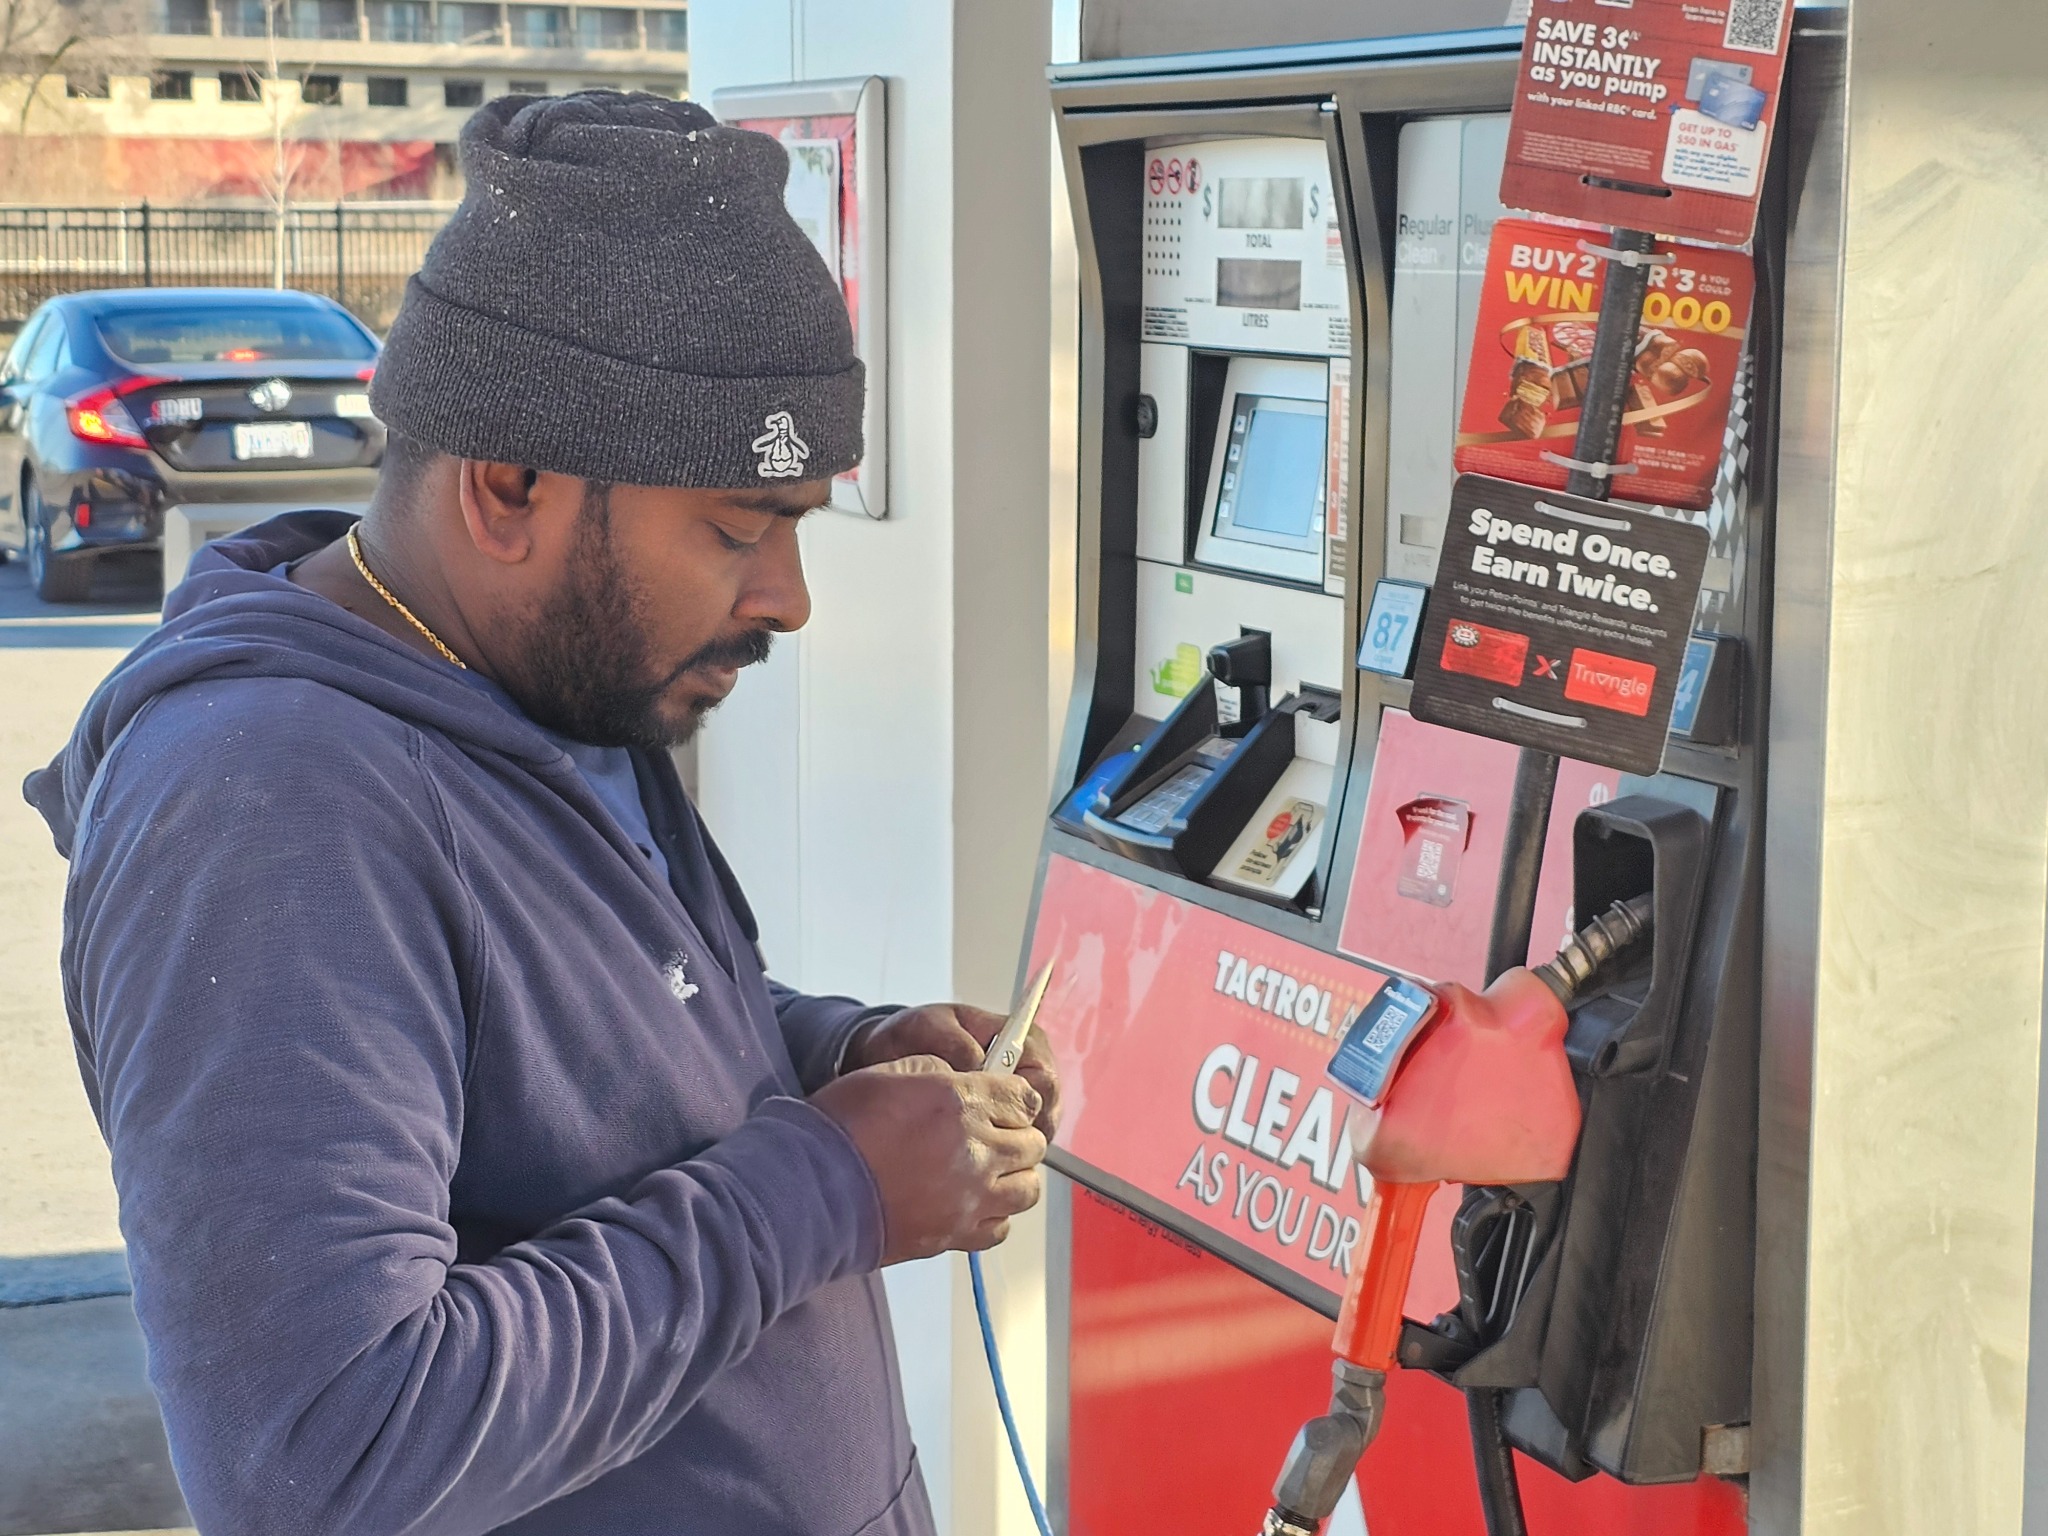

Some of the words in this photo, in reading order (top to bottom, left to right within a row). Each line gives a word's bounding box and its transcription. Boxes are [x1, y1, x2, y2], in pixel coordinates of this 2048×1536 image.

[1536, 17, 1597, 46] SAVE
[1532, 41, 1661, 79] INSTANTLY
[1527, 92, 1549, 104] with
[1550, 97, 1574, 107] your
[1575, 98, 1605, 112] linked
[1530, 66, 1556, 82] as
[1559, 70, 1601, 90] you
[1604, 77, 1667, 103] pump
[1677, 134, 1696, 146] $50
[1699, 139, 1711, 148] IN
[1679, 122, 1698, 133] GET
[1701, 126, 1715, 134] UP
[1717, 128, 1732, 138] TO
[1203, 183, 1212, 221] $
[1309, 182, 1319, 222] $
[1245, 234, 1272, 248] TOTAL
[1399, 213, 1453, 240] Regular
[1464, 213, 1493, 236] Plu
[1398, 242, 1438, 264] Clean
[1463, 241, 1489, 265] Cle
[1510, 244, 1577, 274] BUY
[1576, 254, 1596, 278] 2
[1647, 265, 1668, 288] R
[1671, 267, 1696, 292] $3
[1698, 284, 1732, 295] COULD
[1709, 275, 1730, 285] YOU
[1505, 270, 1593, 312] WIN
[1643, 292, 1731, 333] 000
[1242, 313, 1270, 329] LITRES
[1468, 508, 1579, 556] Spend
[1582, 534, 1677, 579] Once.
[1471, 545, 1550, 588] Earn
[1556, 562, 1659, 614] Twice.
[1453, 580, 1469, 592] Link
[1470, 587, 1488, 596] your
[1541, 603, 1558, 612] and
[1559, 604, 1591, 620] Triangle
[1629, 623, 1668, 638] accounts
[1460, 595, 1469, 604] to
[1470, 598, 1485, 608] get
[1485, 601, 1507, 612] twice
[1507, 606, 1522, 616] the
[1522, 610, 1556, 624] benefits
[1556, 619, 1588, 631] without
[1588, 626, 1601, 637] any
[1603, 630, 1625, 640] extra
[1372, 611, 1409, 651] 87
[1676, 668, 1699, 711] 4
[1213, 950, 1332, 1037] TACTROL
[1176, 1142, 1230, 1205] AS
[1232, 1162, 1310, 1246] YOU
